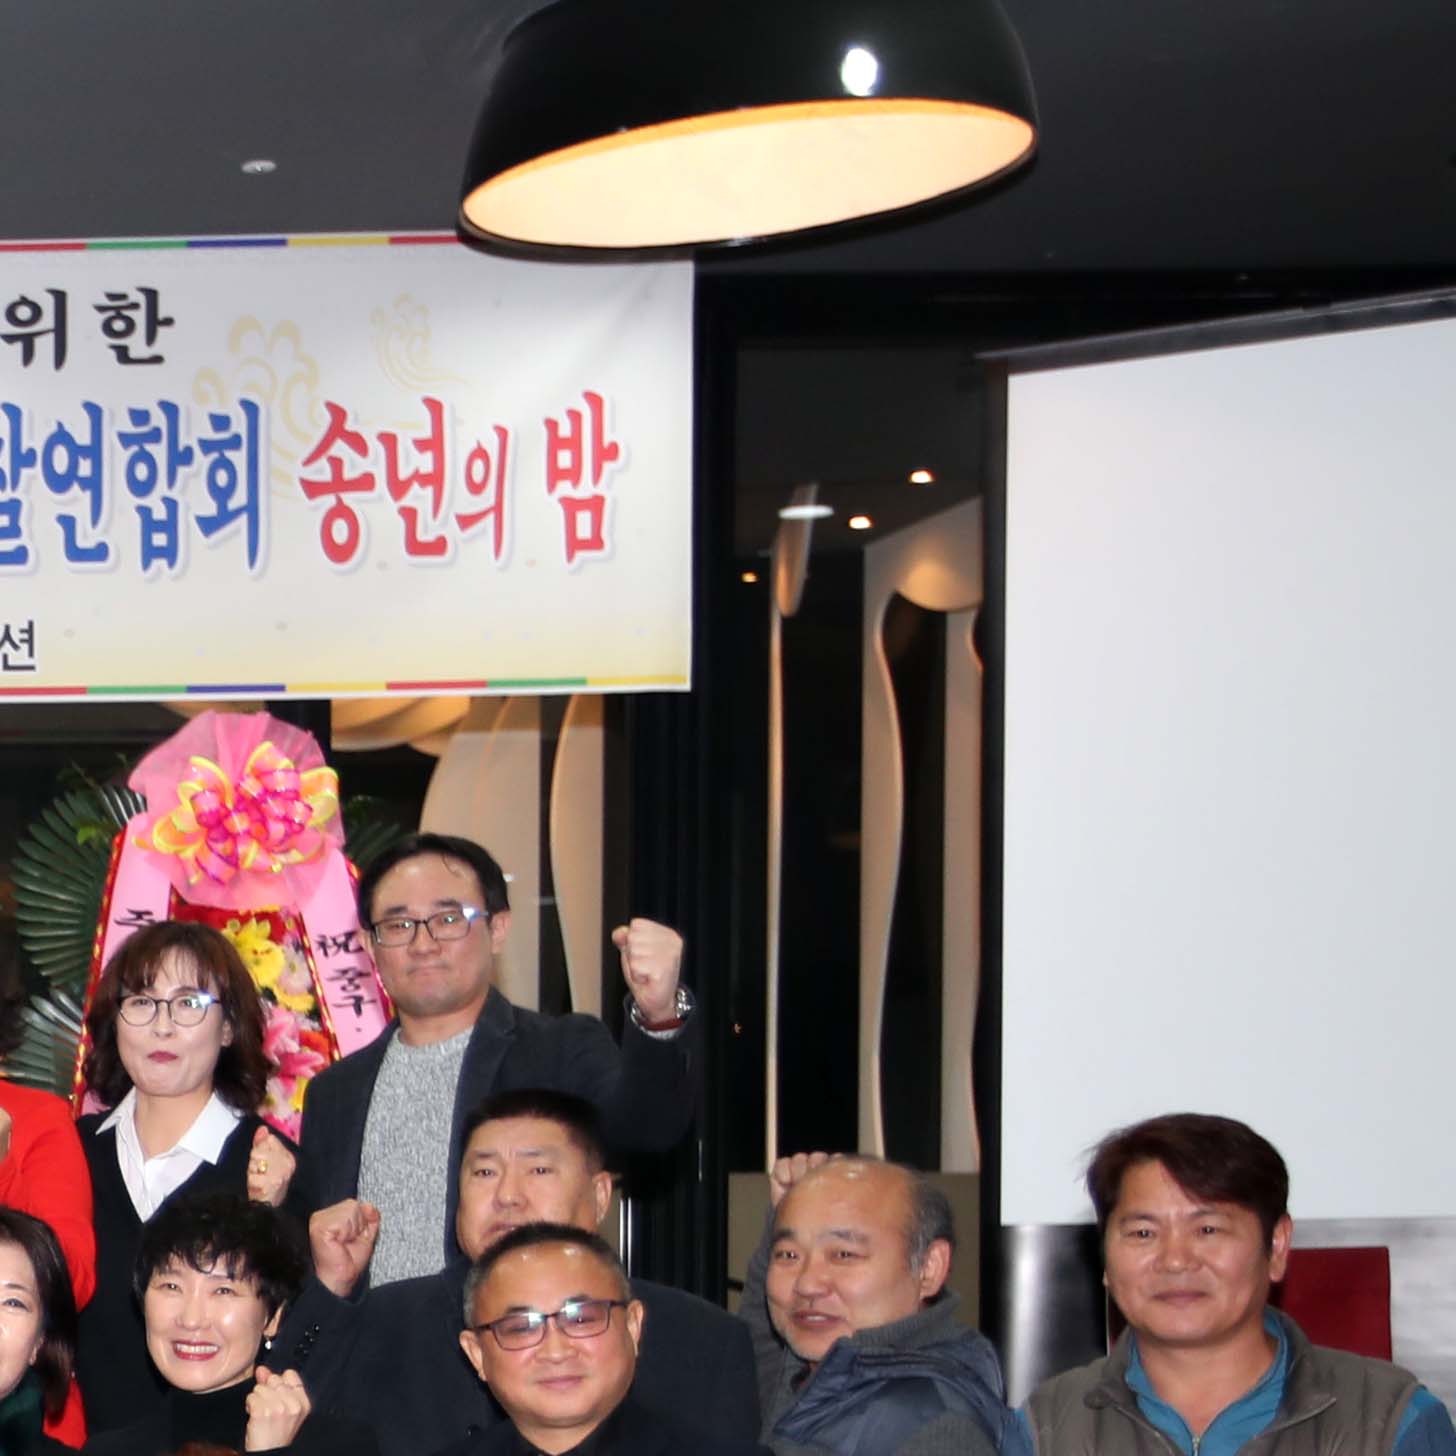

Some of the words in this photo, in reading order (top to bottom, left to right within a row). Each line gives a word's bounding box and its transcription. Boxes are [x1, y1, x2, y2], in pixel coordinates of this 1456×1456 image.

[0, 287, 175, 370] 위한
[300, 397, 509, 565] 송년의
[545, 391, 620, 562] 밤
